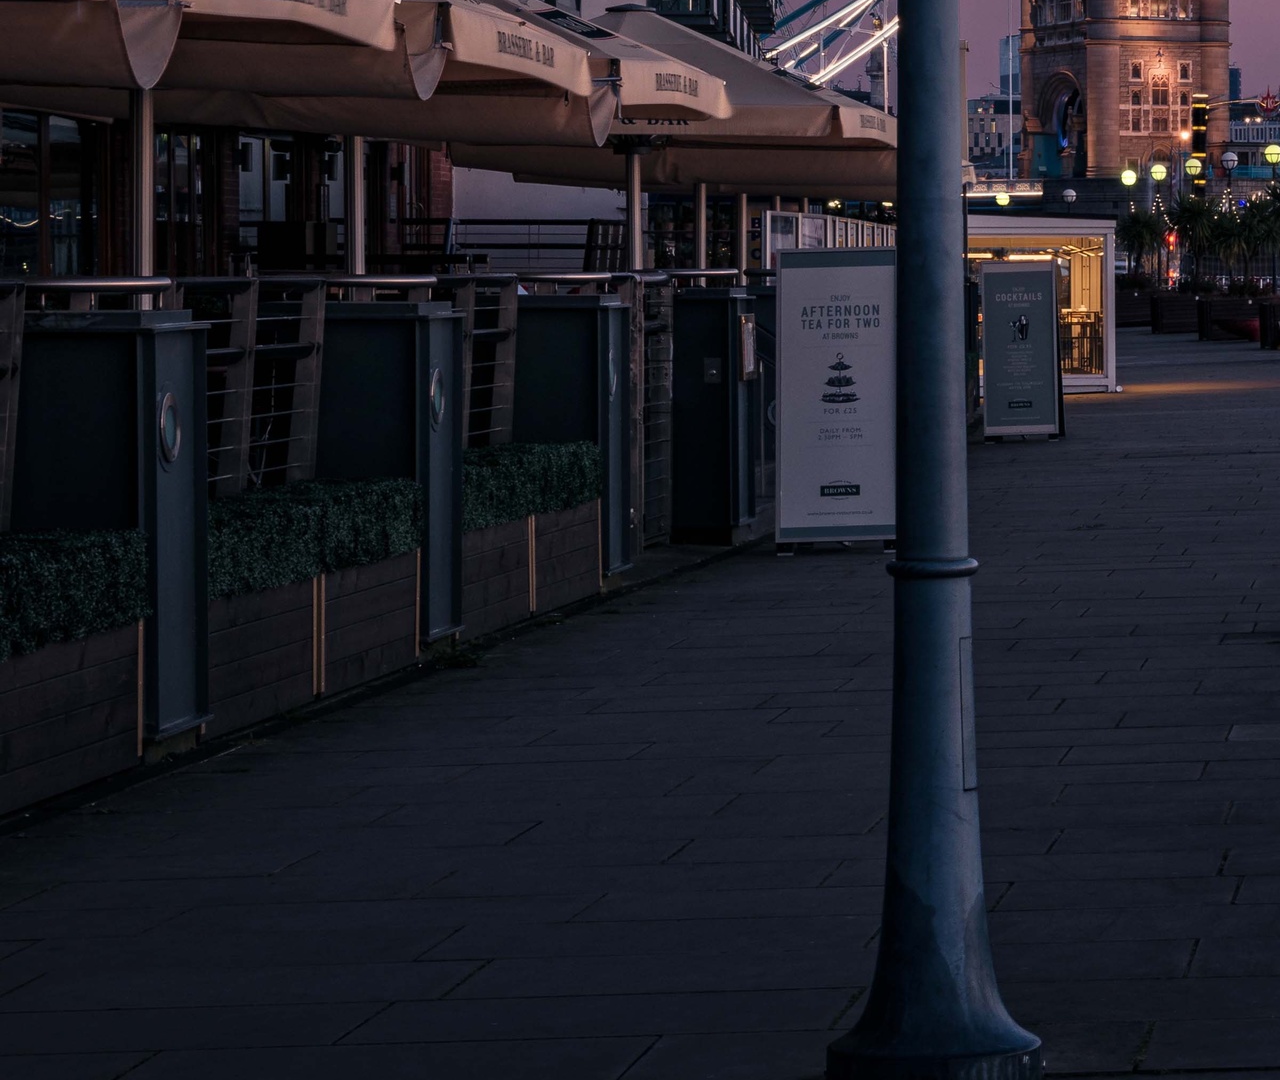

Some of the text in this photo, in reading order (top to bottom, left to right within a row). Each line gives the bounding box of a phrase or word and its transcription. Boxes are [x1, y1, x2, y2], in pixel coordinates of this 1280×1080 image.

[497, 30, 555, 68] BRASSERIE & BAR
[655, 72, 699, 98] BRASSERIE & BAR
[830, 294, 851, 302] ENJOY
[995, 292, 1043, 302] COCKTAILS
[801, 304, 881, 318] AFTERNOON
[801, 317, 880, 330] TEA FOR TWO
[822, 332, 859, 340] AT BROWNS
[824, 486, 857, 494] BROWNS
